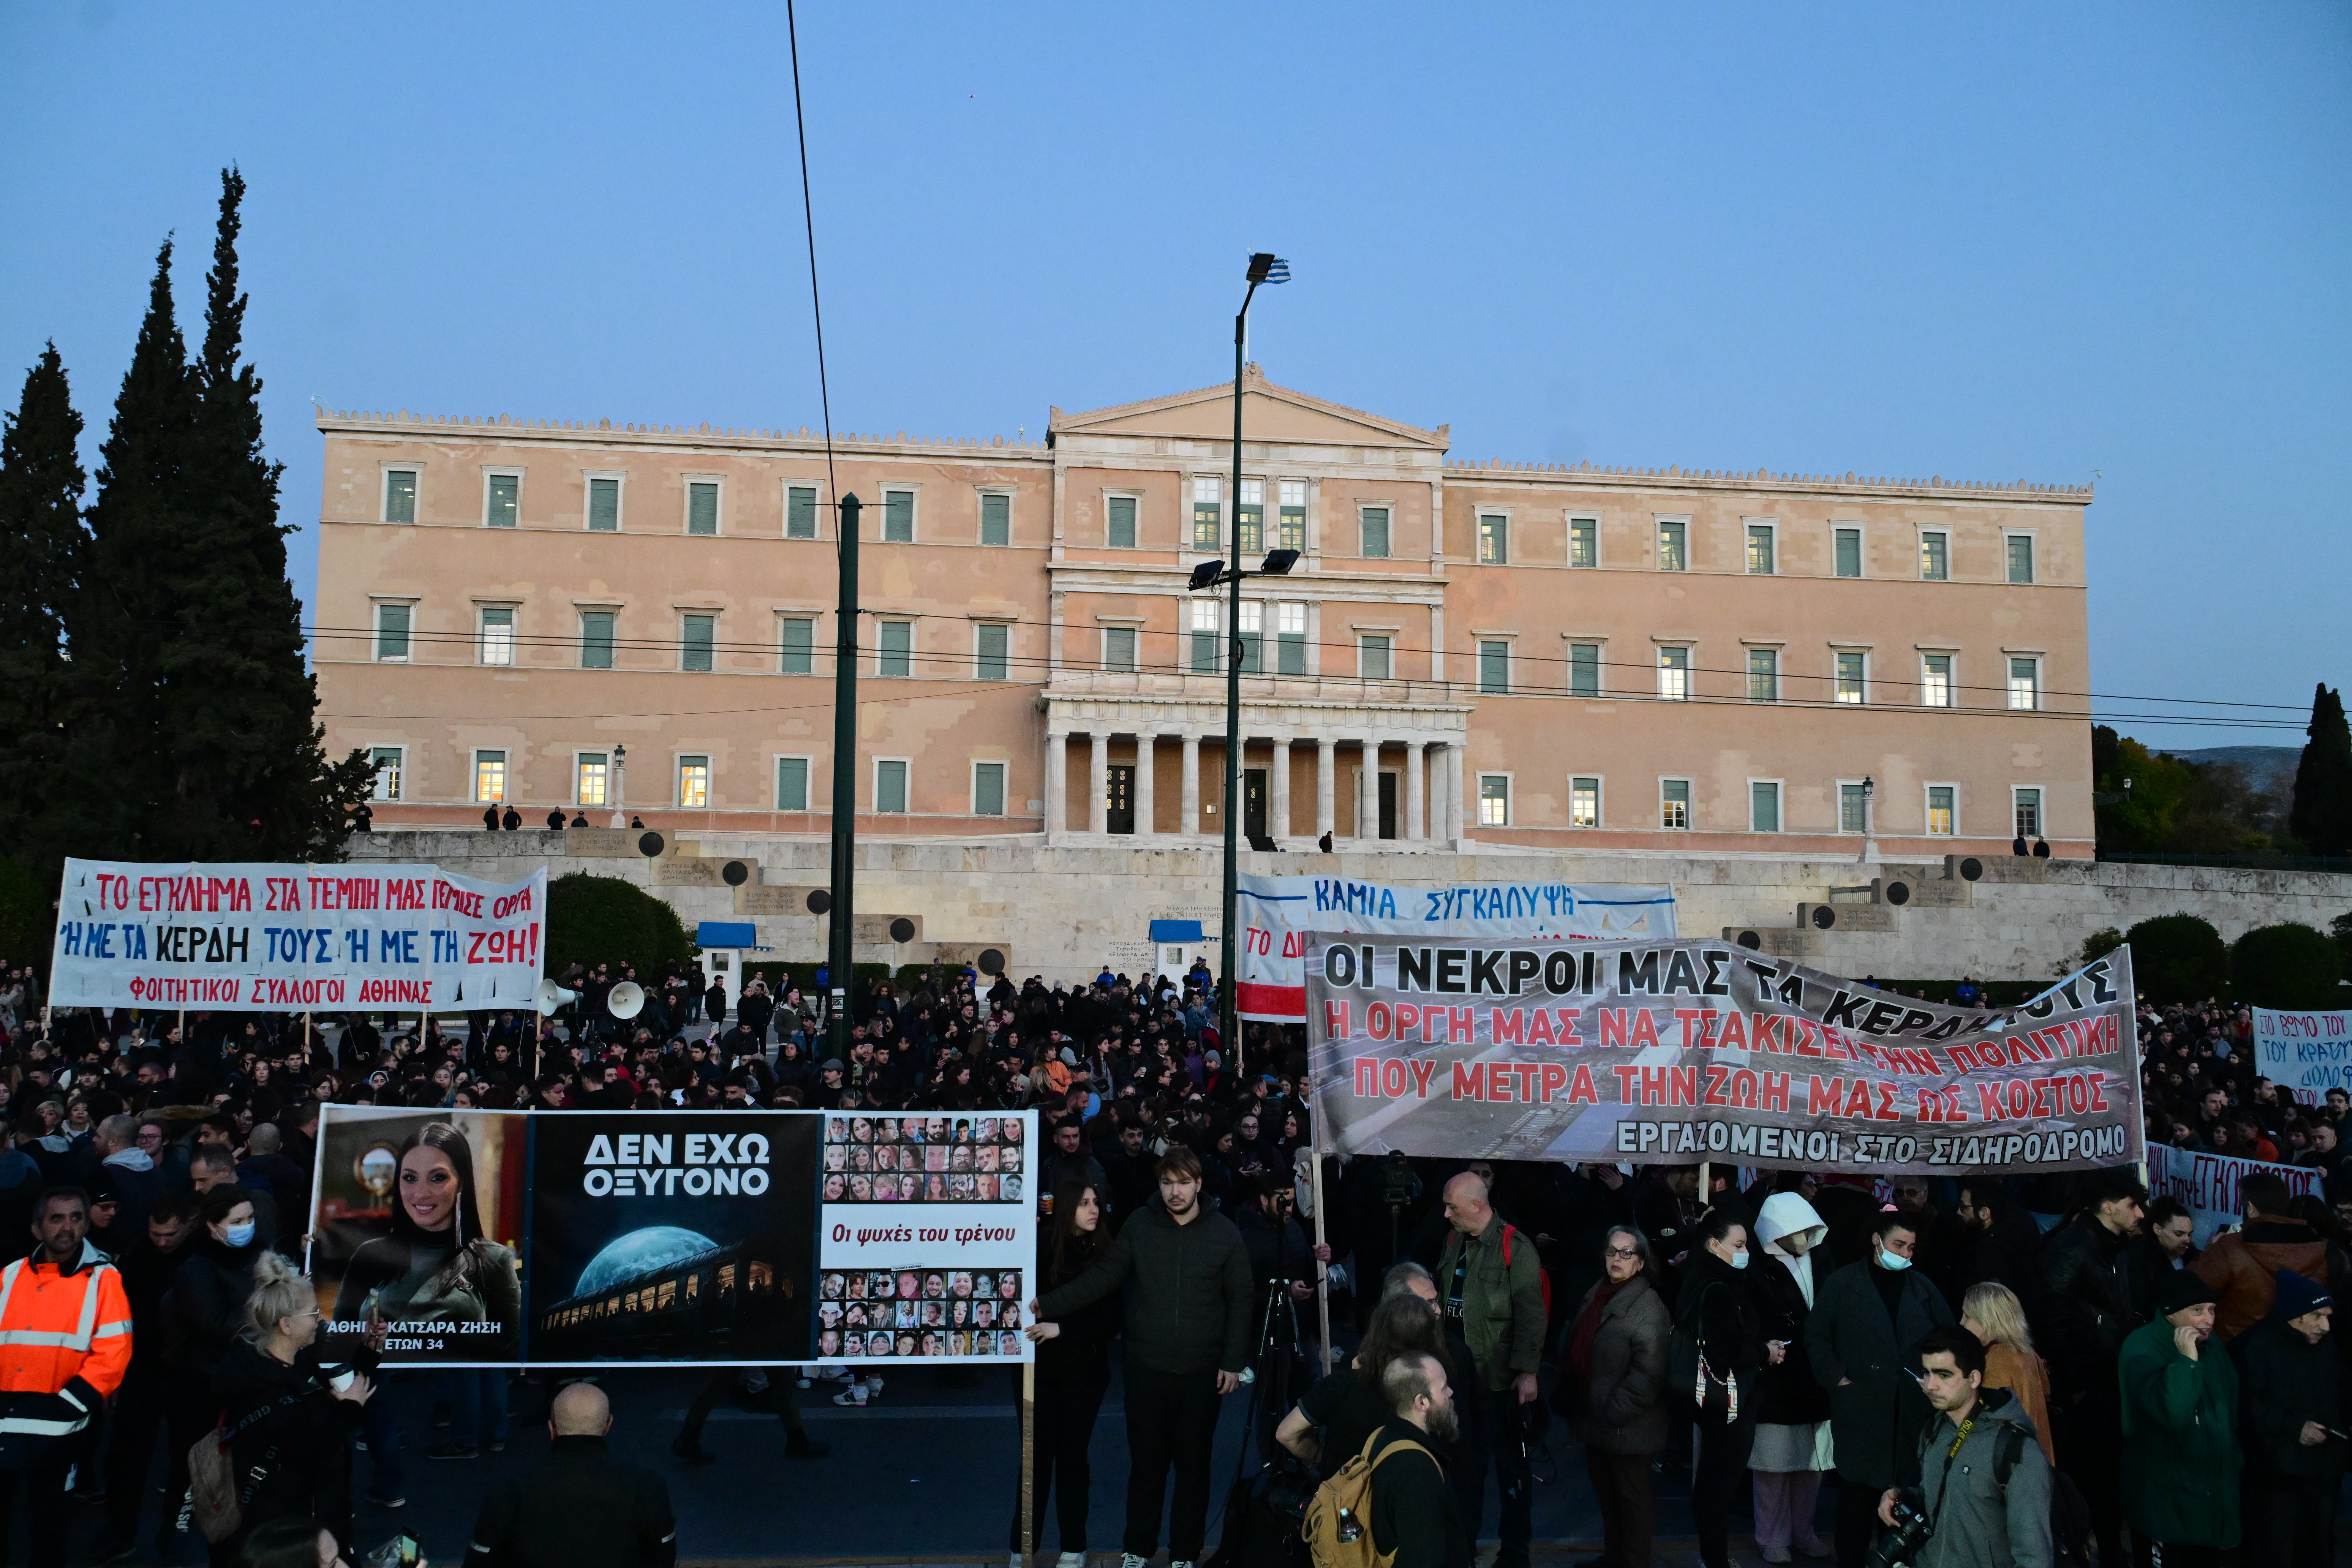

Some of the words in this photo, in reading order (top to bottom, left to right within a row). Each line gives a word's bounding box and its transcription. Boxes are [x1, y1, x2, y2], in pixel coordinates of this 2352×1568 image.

[96, 874, 129, 910] ΤΟ
[139, 877, 251, 912] ΕΓΚΛΗΜΑ
[266, 878, 300, 911] ΣΤΑ
[308, 877, 379, 910] ΤΕΜΠΗ
[386, 879, 426, 910] ΜΑΣ
[432, 879, 485, 919] ΓΕΜΙΣΕ
[493, 884, 531, 919] ΟΡΓΗ
[1315, 880, 1396, 920] ΚΑΜΙΑ
[1424, 885, 1573, 921] ΣΥΓΚΑΛΥΨΗ
[85, 923, 116, 958] ΜΕ
[122, 925, 147, 960] ΤΑ
[156, 925, 249, 962] ΚΕΡΔΗ
[264, 927, 332, 963] ΤΟΥΣ
[381, 930, 419, 963] ΜΕ
[430, 930, 457, 963] ΤΗ
[1246, 927, 1270, 956] ΤΟ
[130, 976, 239, 1002] ΦΟΙΤΗΤΙΚΟΙ
[251, 979, 344, 1004] ΣΥΛΛΟΓΟΙ
[359, 980, 432, 1004] ΑΘΗΝΑΣ
[1324, 943, 1375, 989] ΟΙ
[1396, 945, 1595, 996] ΝΕΚΡΟΙ
[1618, 948, 1731, 996] ΜΑΣ
[1745, 958, 1805, 1010] ΤΑ
[1325, 1000, 1350, 1039] Η
[1366, 1001, 1475, 1044] ΟΡΓΗ
[1491, 1007, 1583, 1046] ΜΑΣ
[1599, 1007, 1660, 1048] ΝΑ
[1674, 1008, 1860, 1063] ΤΣΑΚΙΣΕΙ
[1857, 1040, 1944, 1076] ΤΗΝ
[1944, 1014, 2119, 1075] ΠΟΛΙΤΙΚΗ
[2260, 1015, 2275, 1035] ΣΤΟ
[2322, 1015, 2346, 1037] ΤΟΥ
[2262, 1040, 2286, 1062] ΤΟΥ
[1354, 1057, 1437, 1099] ΠΟΥ
[1452, 1062, 1600, 1105] ΜΕΤΡΑ
[1613, 1064, 1696, 1106] ΤΗΝ
[1705, 1065, 1791, 1113] ΖΩΗ
[1808, 1075, 1900, 1122] ΜΑΣ
[1916, 1084, 1968, 1123] ΩΣ
[1976, 1073, 2109, 1122] ΚΟΣΤΟΣ
[583, 1134, 672, 1165] ΔΕΝ
[684, 1133, 769, 1164] ΕΧΩ
[1617, 1120, 1841, 1162] ΕΡΓΑΖΟΜΕΝΟΙ
[1853, 1133, 1917, 1164] ΣΤΟ
[1928, 1124, 2126, 1165] ΣΙΔΗΡΟΔΡΟΜΟ
[583, 1167, 769, 1197] ΟΞΥΓΟΝΟ
[832, 1224, 851, 1242] Οι
[857, 1223, 912, 1247] ψυχές
[919, 1228, 948, 1242] του
[955, 1223, 1016, 1246] τρένου
[327, 1320, 367, 1333] ΑΘΗ
[387, 1321, 456, 1334] ΚΑΤΣΑΡΑ
[460, 1321, 501, 1334] ΖΗΣΗ
[385, 1339, 422, 1350] ΕΤΩΝ
[427, 1339, 443, 1350] 34
